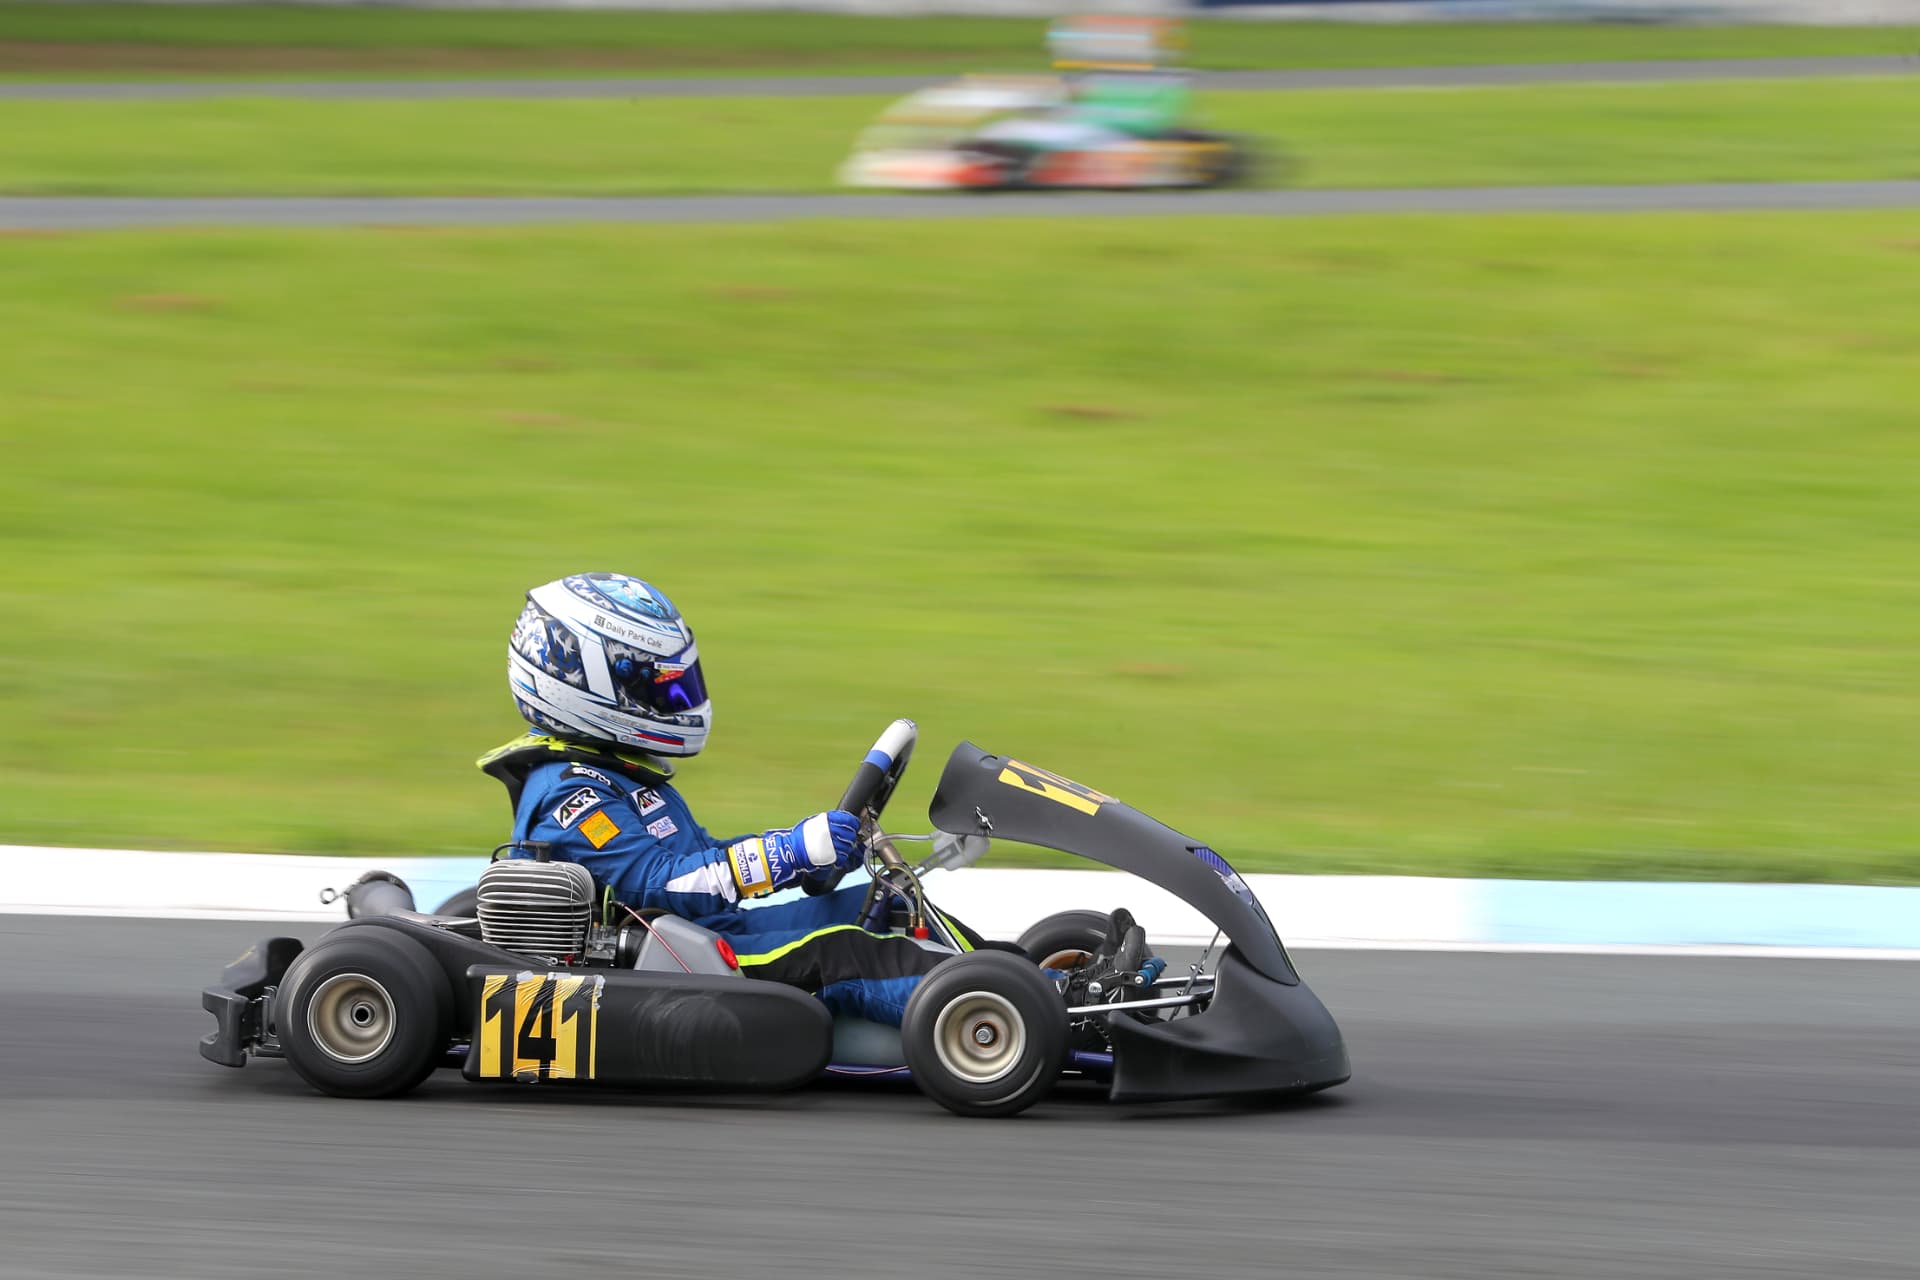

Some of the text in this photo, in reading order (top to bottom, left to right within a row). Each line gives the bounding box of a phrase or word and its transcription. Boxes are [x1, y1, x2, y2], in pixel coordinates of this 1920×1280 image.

[606, 621, 626, 636] Daily
[627, 629, 646, 643] Park
[485, 974, 593, 1080] 141
